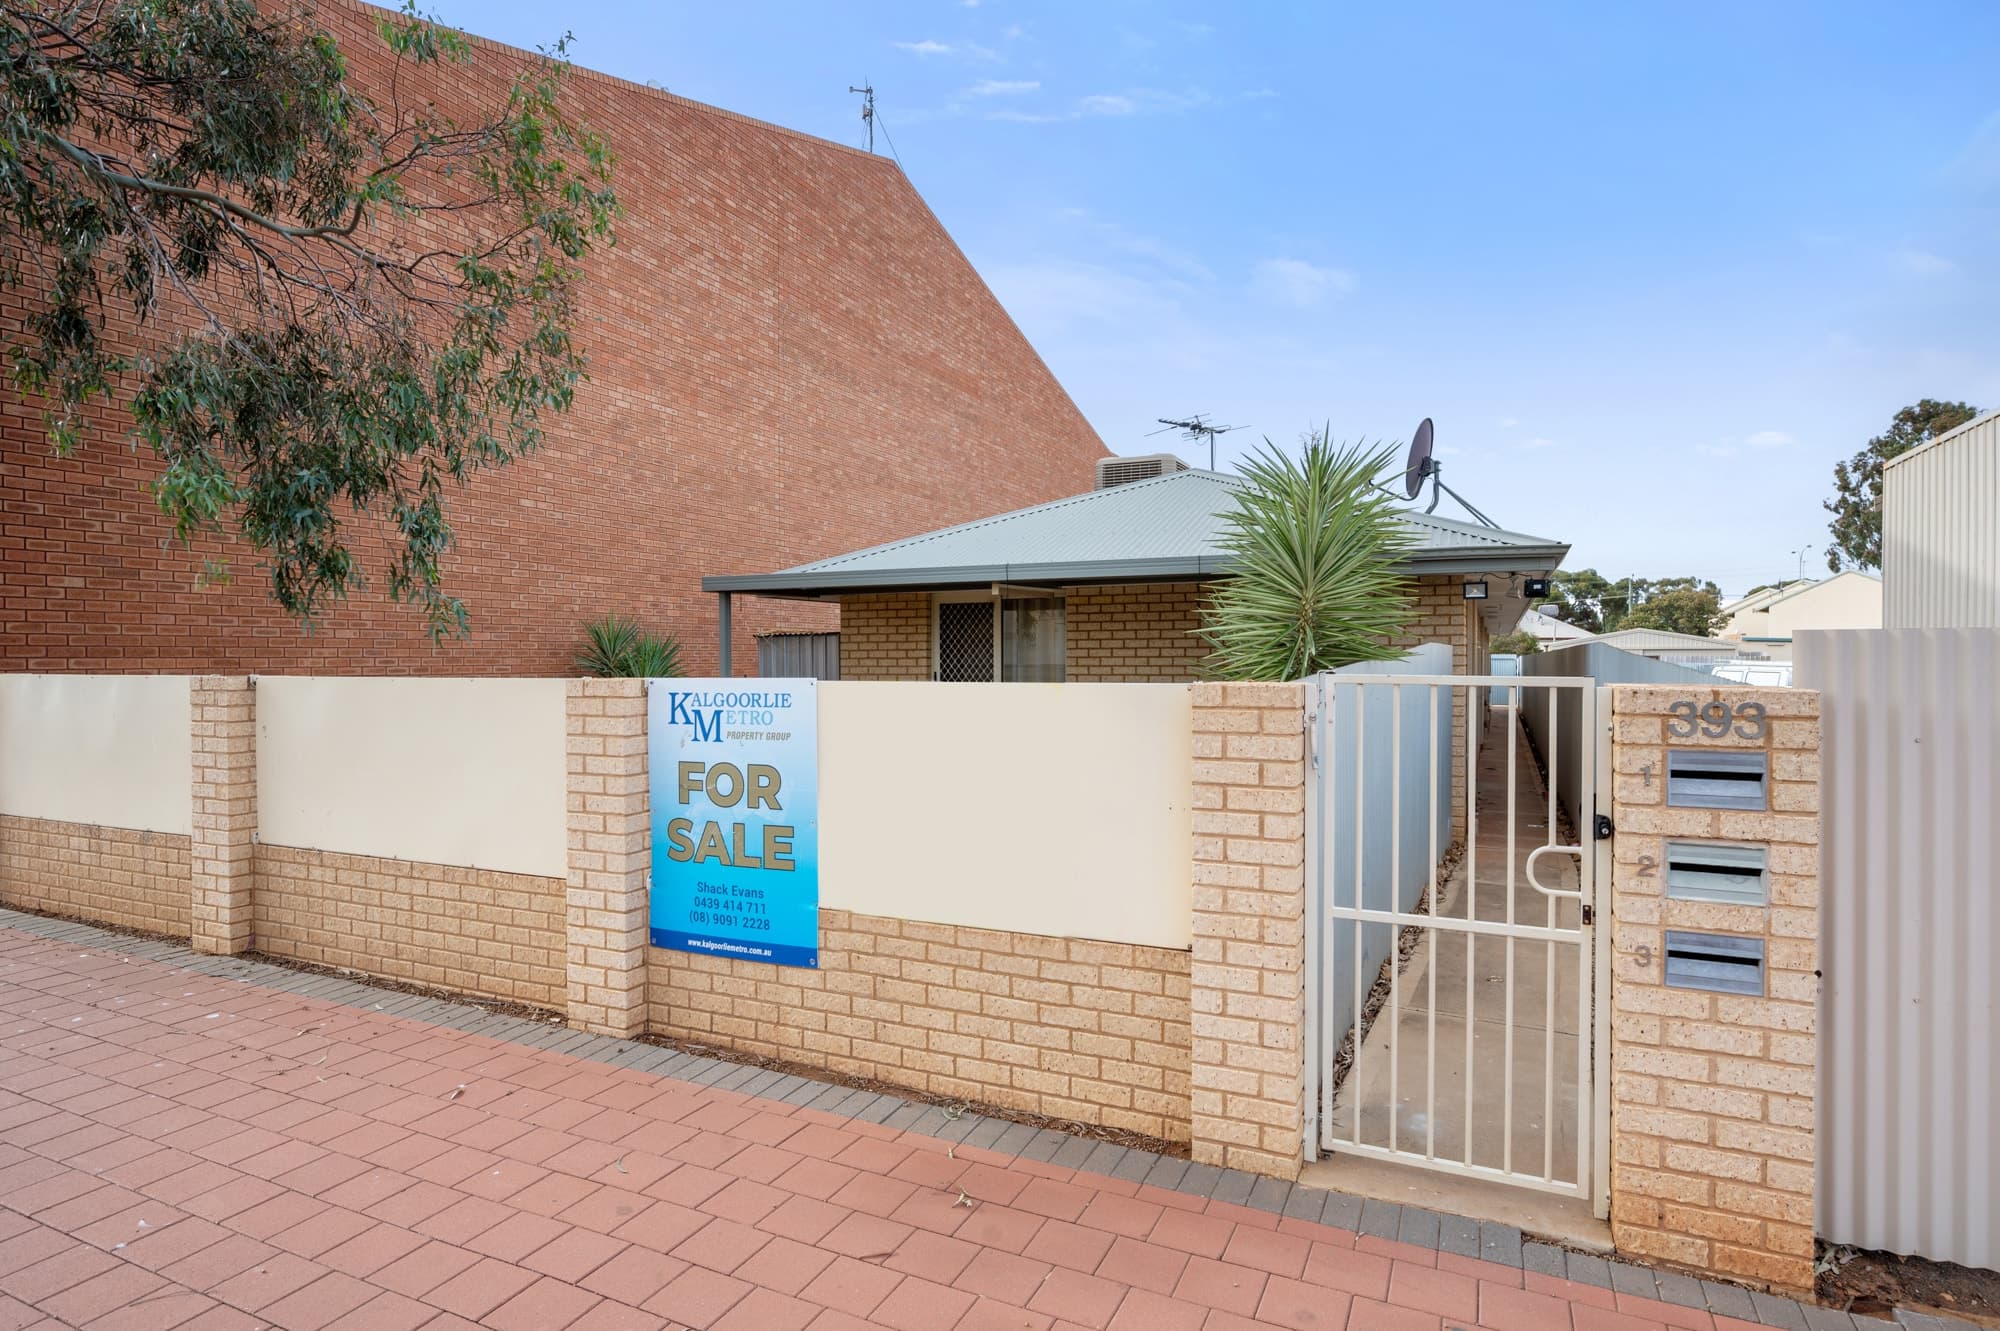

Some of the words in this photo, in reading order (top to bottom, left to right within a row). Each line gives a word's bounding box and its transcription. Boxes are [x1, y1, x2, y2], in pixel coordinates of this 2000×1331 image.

[668, 692, 792, 725] KALGOORLIE
[1668, 700, 1767, 740] 393
[691, 709, 774, 743] METRO
[726, 731, 764, 741] PROPERTY
[765, 732, 792, 741] GROUP
[678, 760, 784, 811] FOR
[1639, 765, 1650, 787] 1
[667, 817, 796, 872] SALE
[1637, 855, 1655, 878] 2
[697, 881, 728, 896] Shack
[731, 885, 765, 899] Evans
[694, 896, 720, 910] 0439
[722, 899, 743, 912] 414
[747, 902, 766, 914] 711
[689, 910, 710, 926] (08)
[713, 914, 738, 927] 9091
[742, 917, 771, 930] 2228
[687, 938, 772, 957] www.kalgoorliemetro.com.au
[1633, 945, 1651, 968] 3
